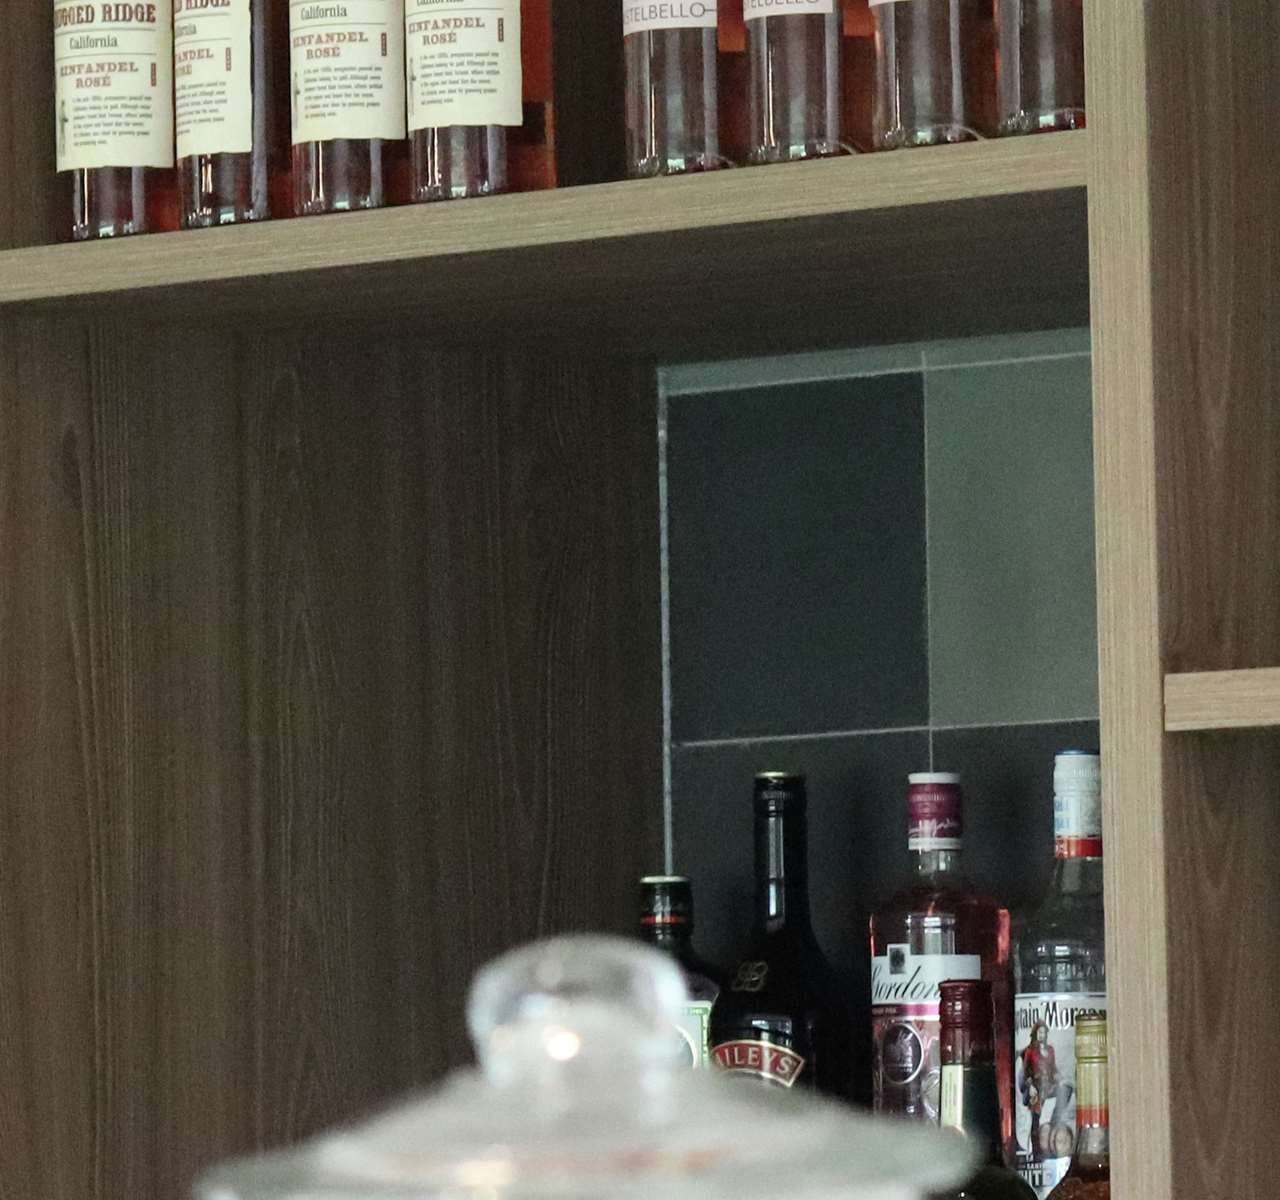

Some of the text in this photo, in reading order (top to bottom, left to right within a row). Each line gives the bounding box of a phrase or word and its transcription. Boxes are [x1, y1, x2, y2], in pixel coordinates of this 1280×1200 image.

[102, 3, 156, 23] RIDGE
[301, 4, 347, 20] California
[69, 35, 118, 50] California
[872, 965, 941, 1000] ordon
[1017, 1169, 1053, 1187] HITE
